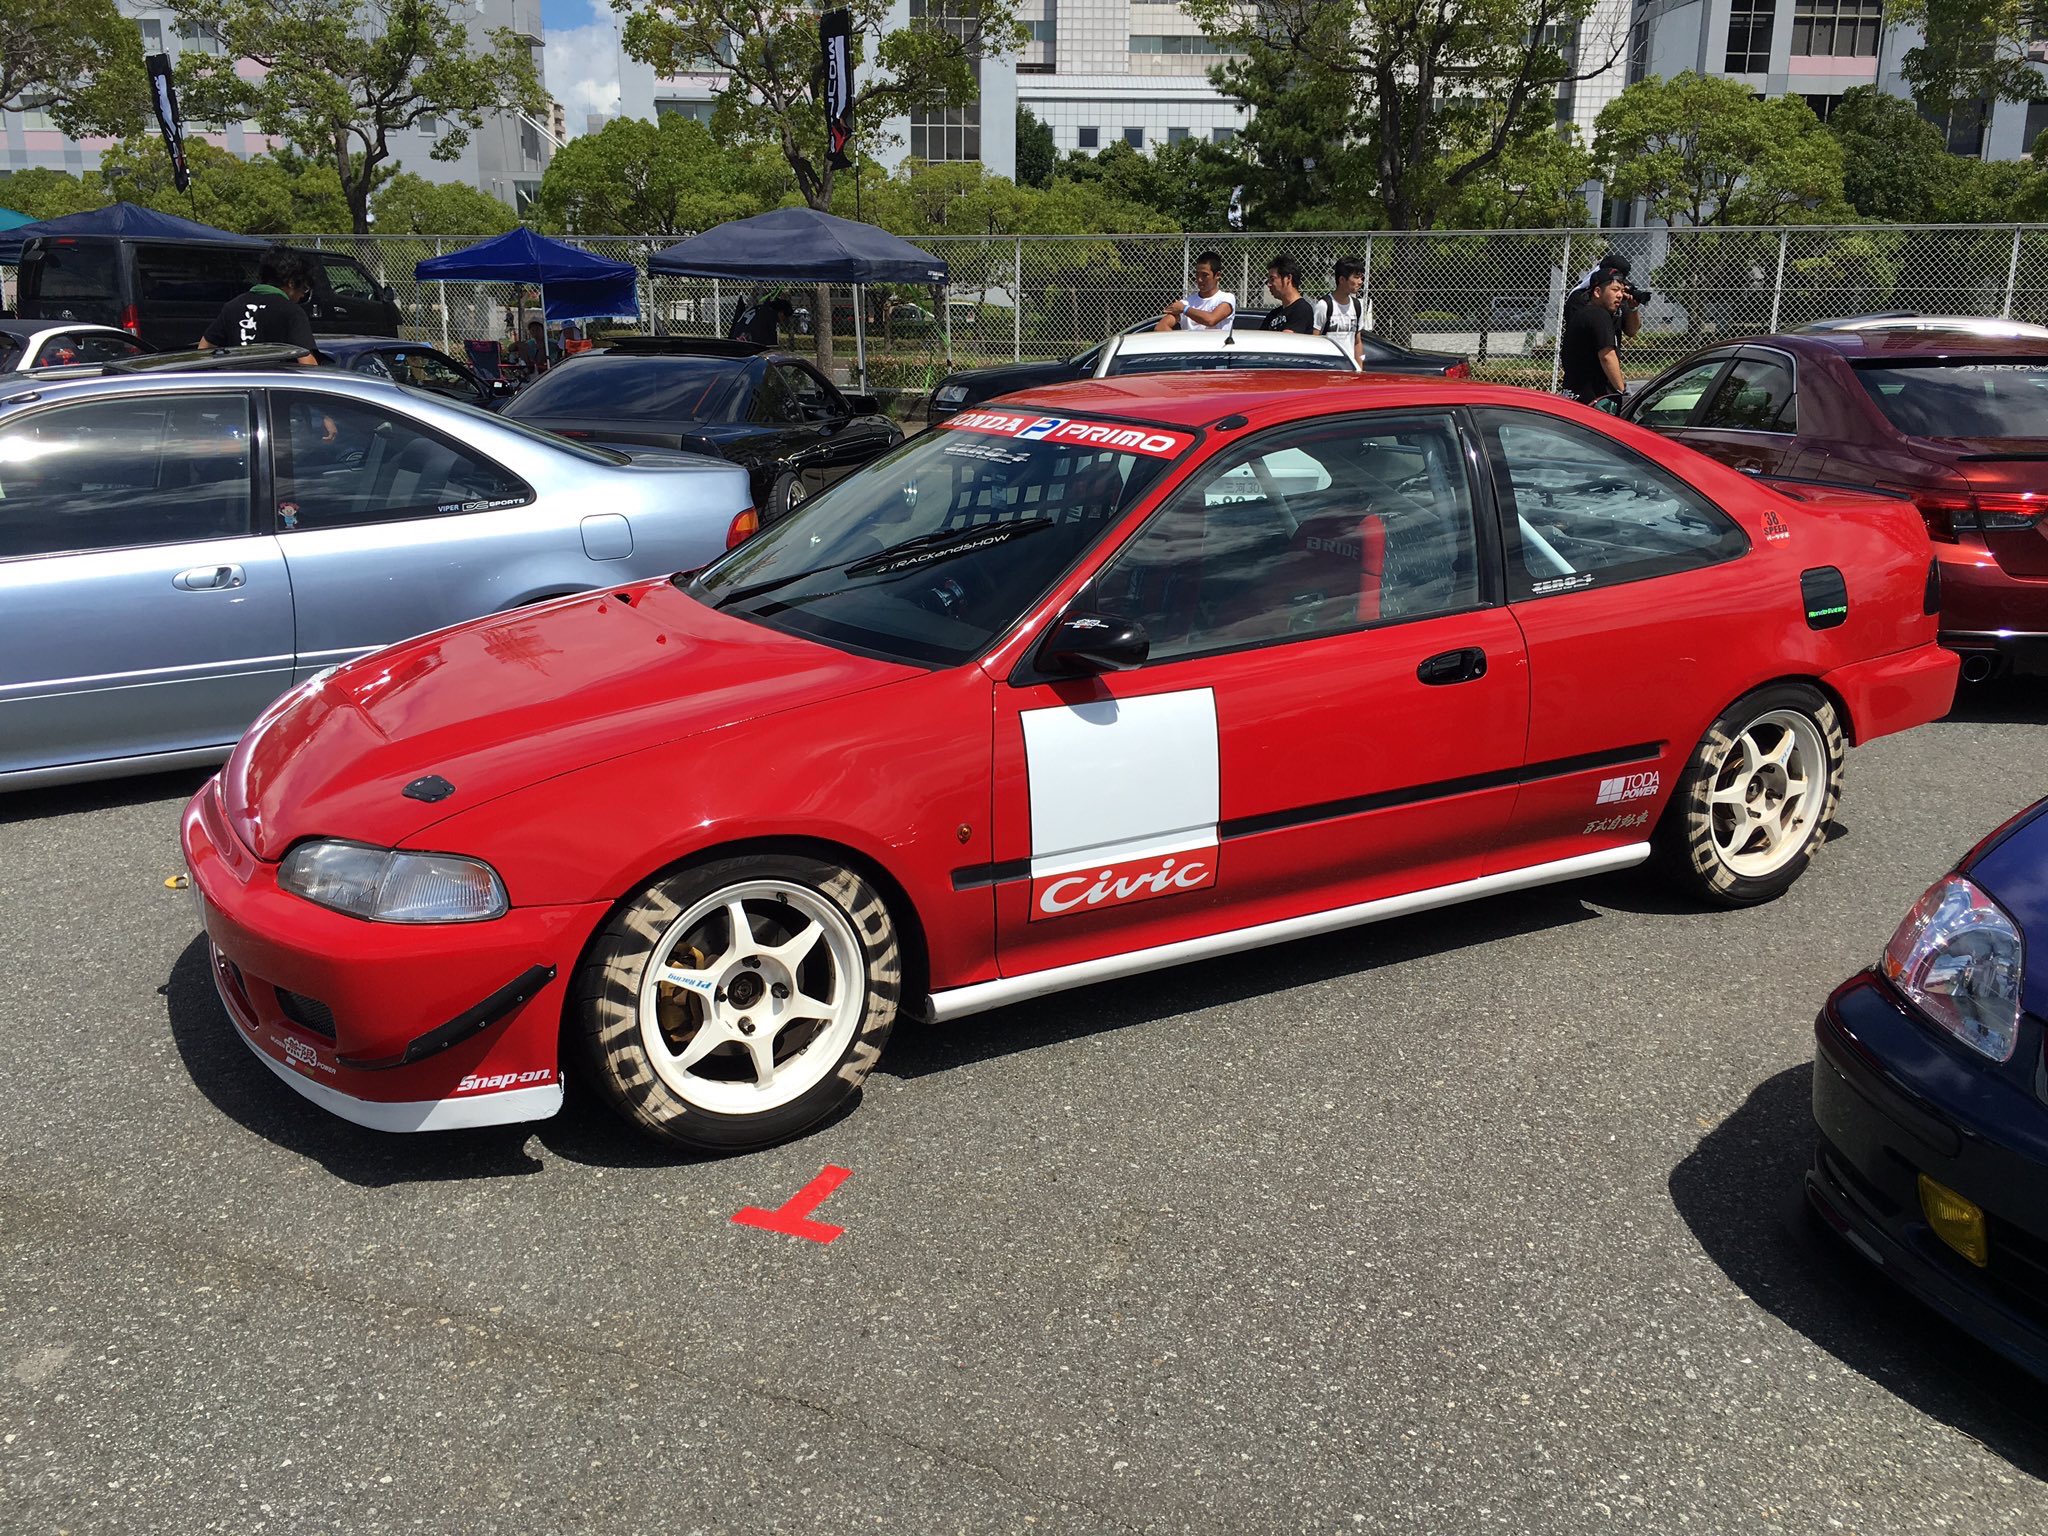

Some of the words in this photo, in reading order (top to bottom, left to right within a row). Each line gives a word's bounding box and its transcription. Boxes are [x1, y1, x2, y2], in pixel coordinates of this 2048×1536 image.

[943, 413, 1025, 432] HONDA
[1055, 423, 1176, 452] PRIMO
[438, 504, 459, 512] VIPER
[489, 498, 525, 507] SPORTS
[1764, 511, 1779, 526] 38
[1763, 524, 1788, 536] SPEED
[1306, 537, 1360, 560] BRIDE
[1626, 770, 1660, 790] TODA
[1621, 785, 1659, 800] POWER
[1039, 858, 1210, 913] Civic
